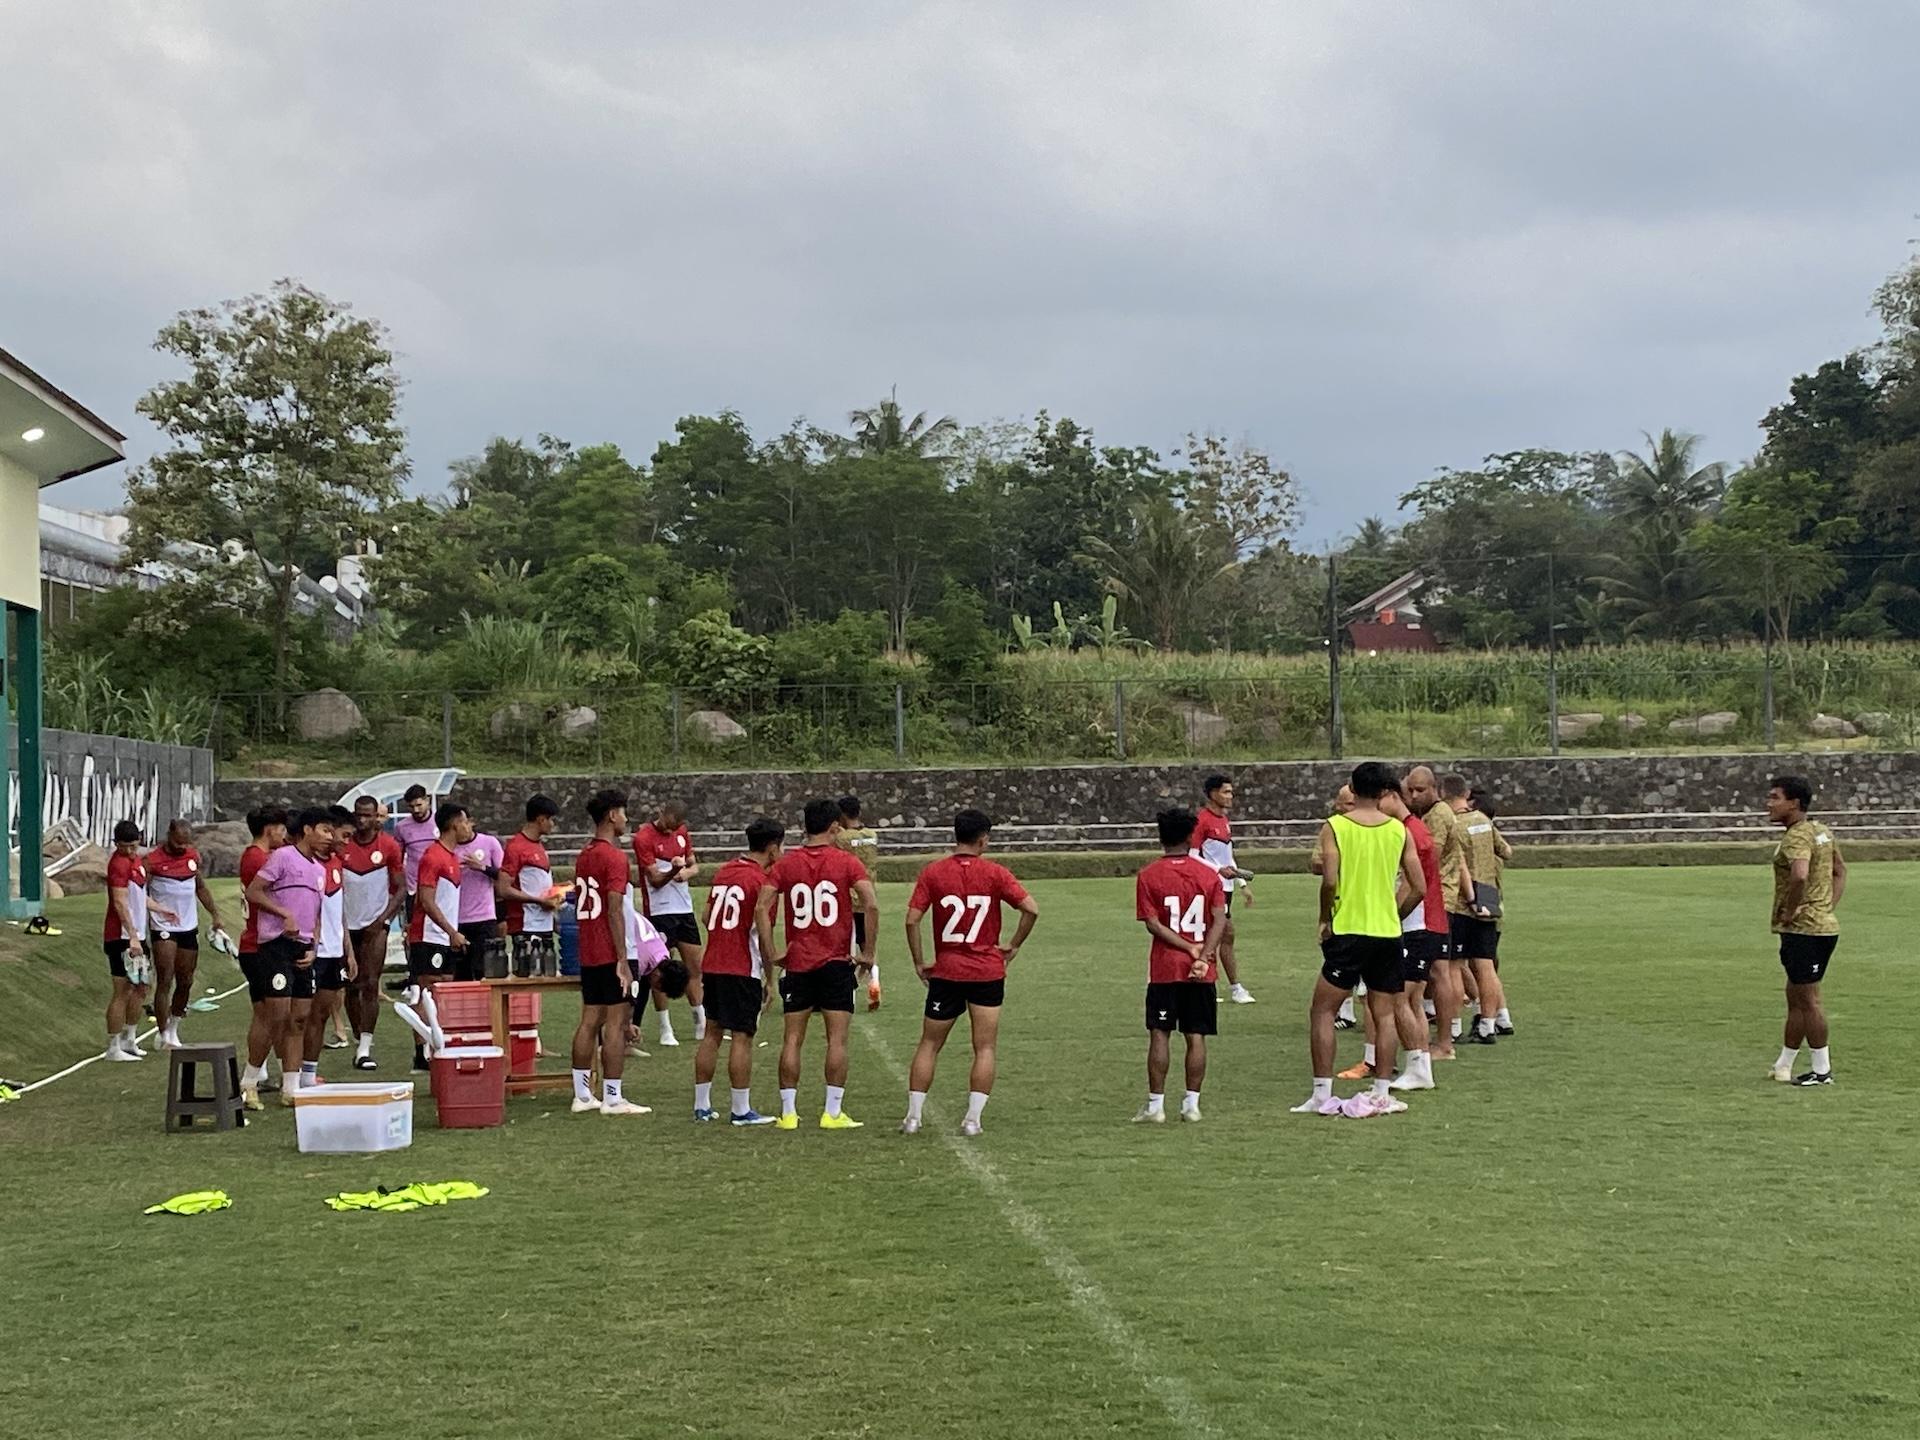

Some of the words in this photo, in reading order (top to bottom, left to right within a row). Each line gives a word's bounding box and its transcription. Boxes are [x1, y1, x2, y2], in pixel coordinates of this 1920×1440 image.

[708, 885, 745, 931] 76
[790, 880, 838, 929] 96
[940, 894, 991, 943] 27
[1164, 894, 1206, 941] 14
